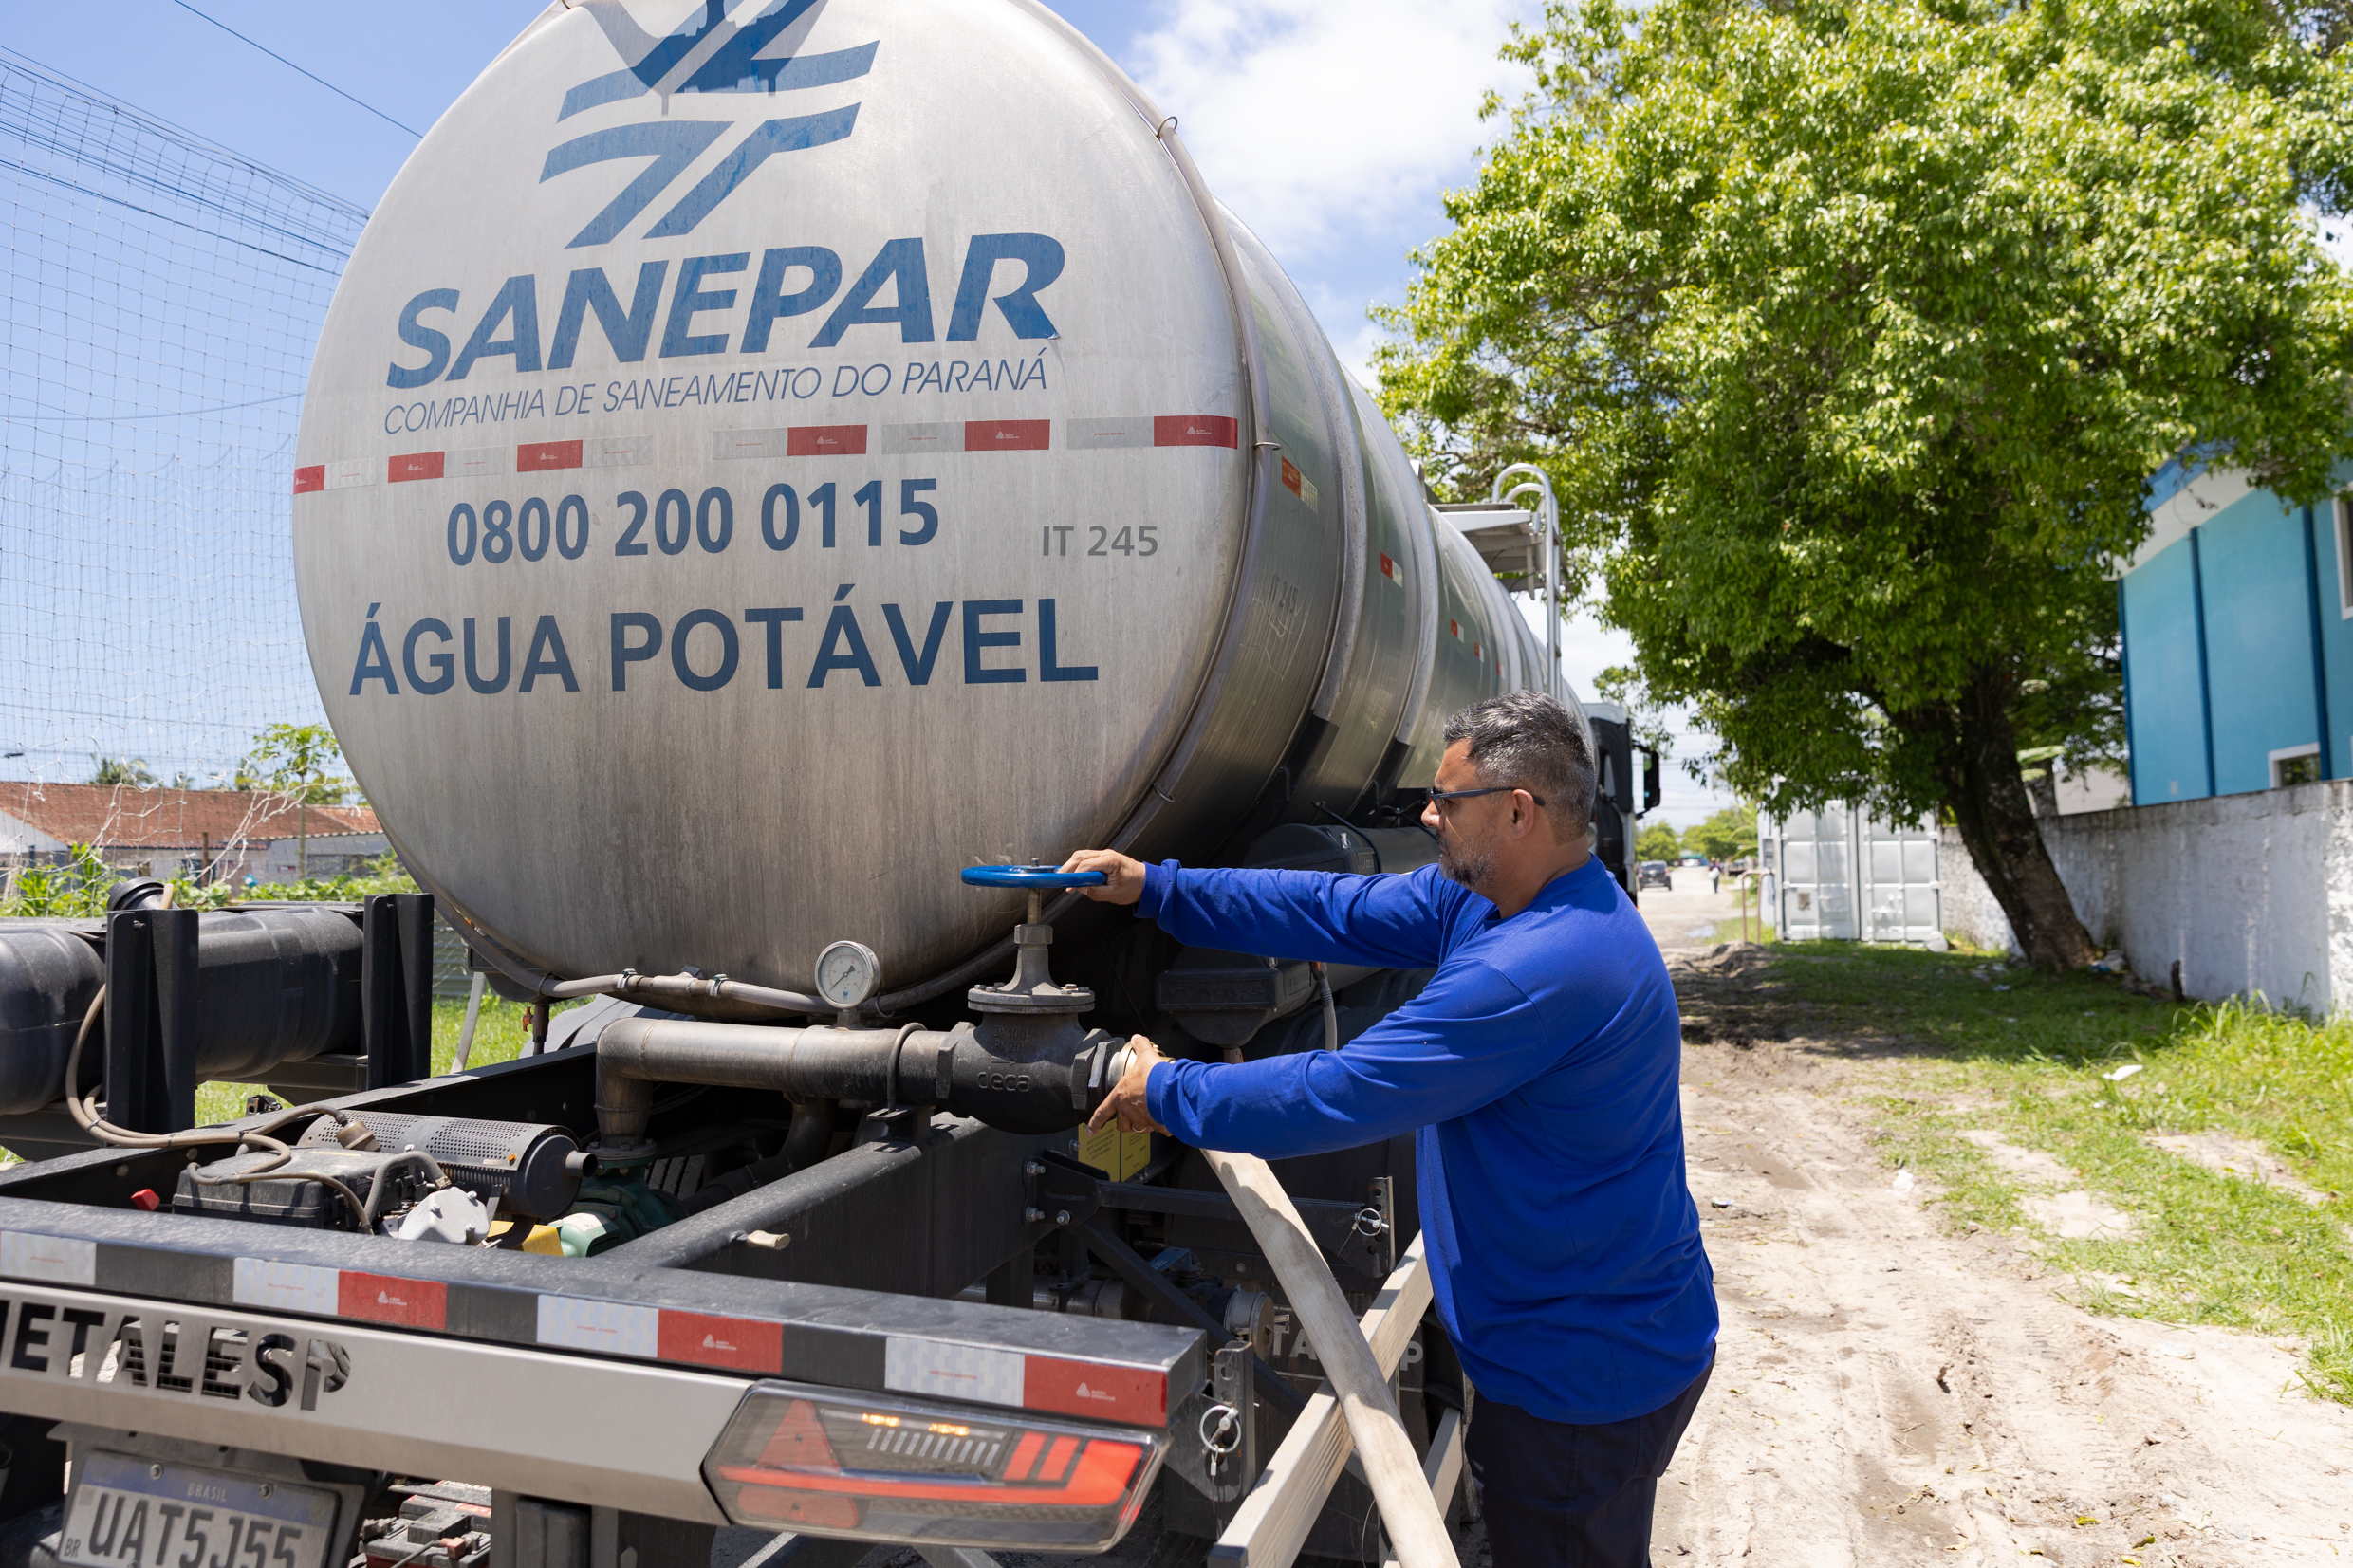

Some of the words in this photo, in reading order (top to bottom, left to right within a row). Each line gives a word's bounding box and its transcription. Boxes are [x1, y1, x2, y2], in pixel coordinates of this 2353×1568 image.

[385, 232, 1065, 389] SANEPAR
[384, 390, 545, 434] COMPANHIA
[555, 383, 595, 415] DE
[603, 367, 822, 412] SANEAMENTO
[832, 363, 892, 397] DO
[901, 346, 1047, 395] PARANÁ
[447, 494, 590, 566] 0800
[615, 486, 733, 557] 200
[761, 478, 939, 551] 0115
[1042, 526, 1075, 557] IT
[1086, 526, 1158, 558] 245
[348, 602, 581, 696] ÁGUA
[611, 583, 1100, 692] POTÁVEL
[0, 1300, 351, 1411] ETALESP
[88, 1492, 303, 1568] UAT5J55
[187, 1483, 227, 1503] BRASIL
[64, 1538, 81, 1559] BR
